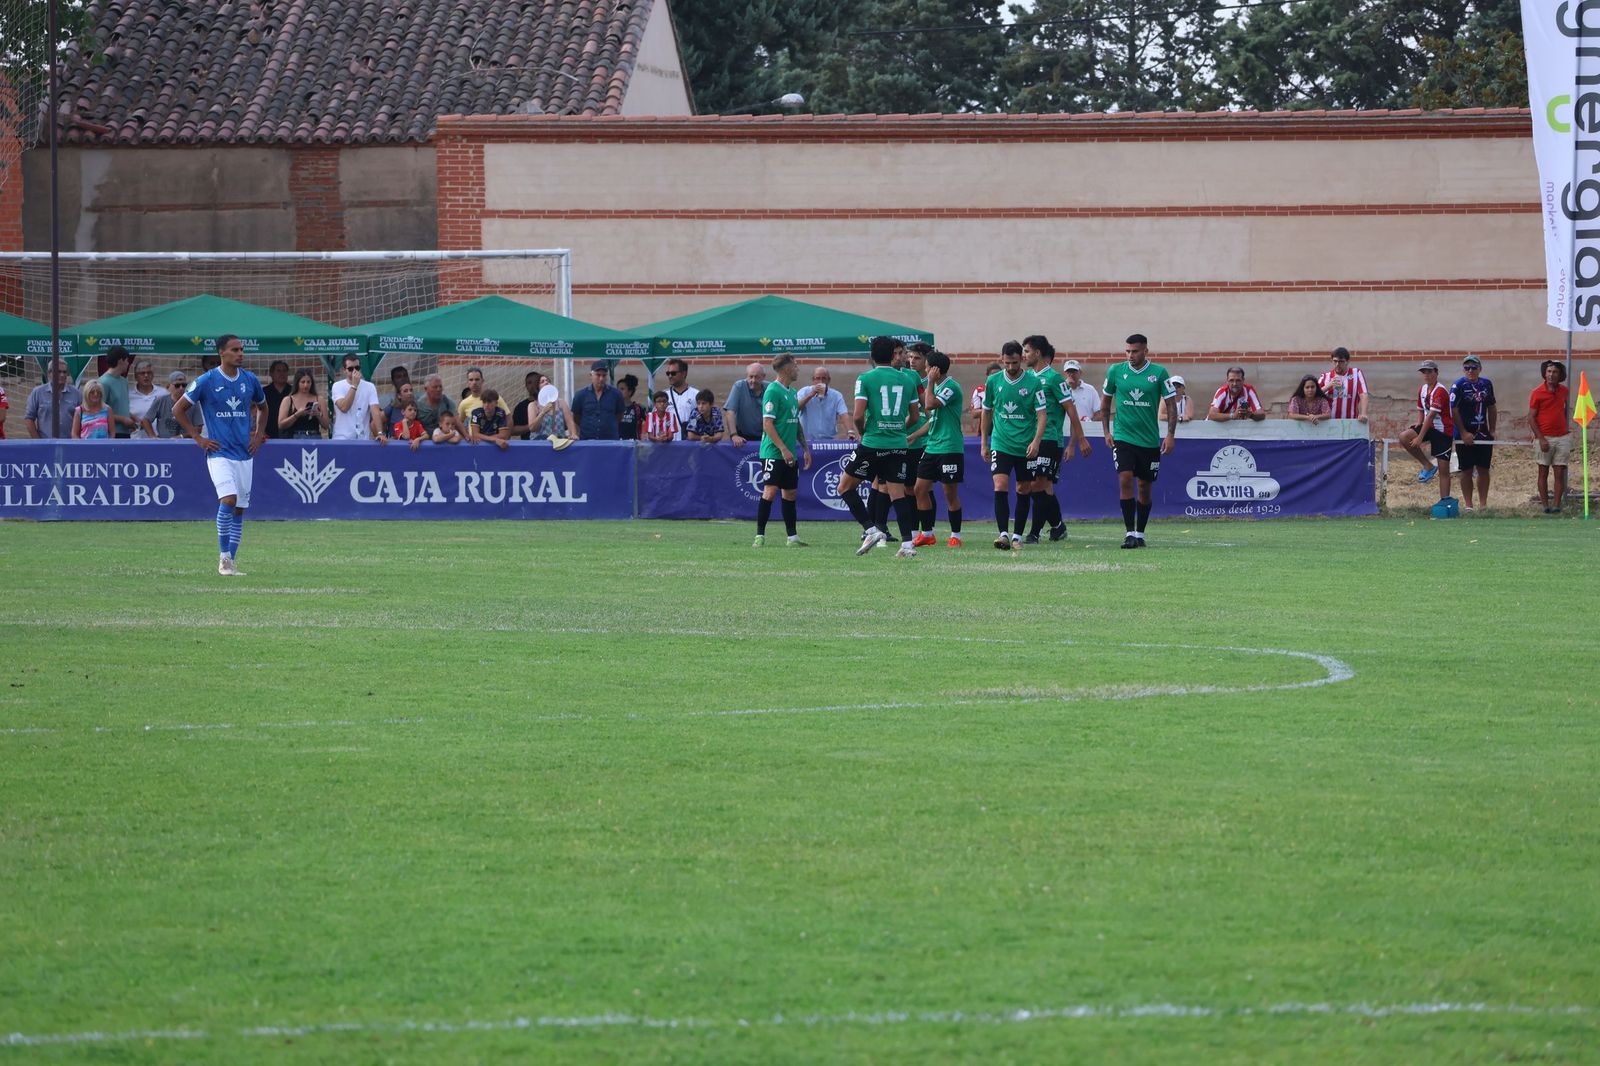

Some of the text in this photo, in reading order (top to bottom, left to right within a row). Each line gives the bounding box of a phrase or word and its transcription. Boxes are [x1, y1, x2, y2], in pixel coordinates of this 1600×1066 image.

[99, 338, 155, 346] CAJA RURAL
[303, 338, 360, 346] CAJA RURAL
[696, 340, 726, 348] RURAL
[772, 337, 826, 346] CAJA RURAL
[879, 385, 904, 416] 17
[991, 450, 997, 462] 2
[0, 462, 172, 479] UNTAMIENTO DE
[764, 458, 775, 471] 15
[350, 470, 587, 506] CAJA RURAL
[1196, 480, 1255, 498] Revilla
[0, 484, 175, 506] LLARALBO
[1185, 502, 1281, 516] Queseros desde 1929
